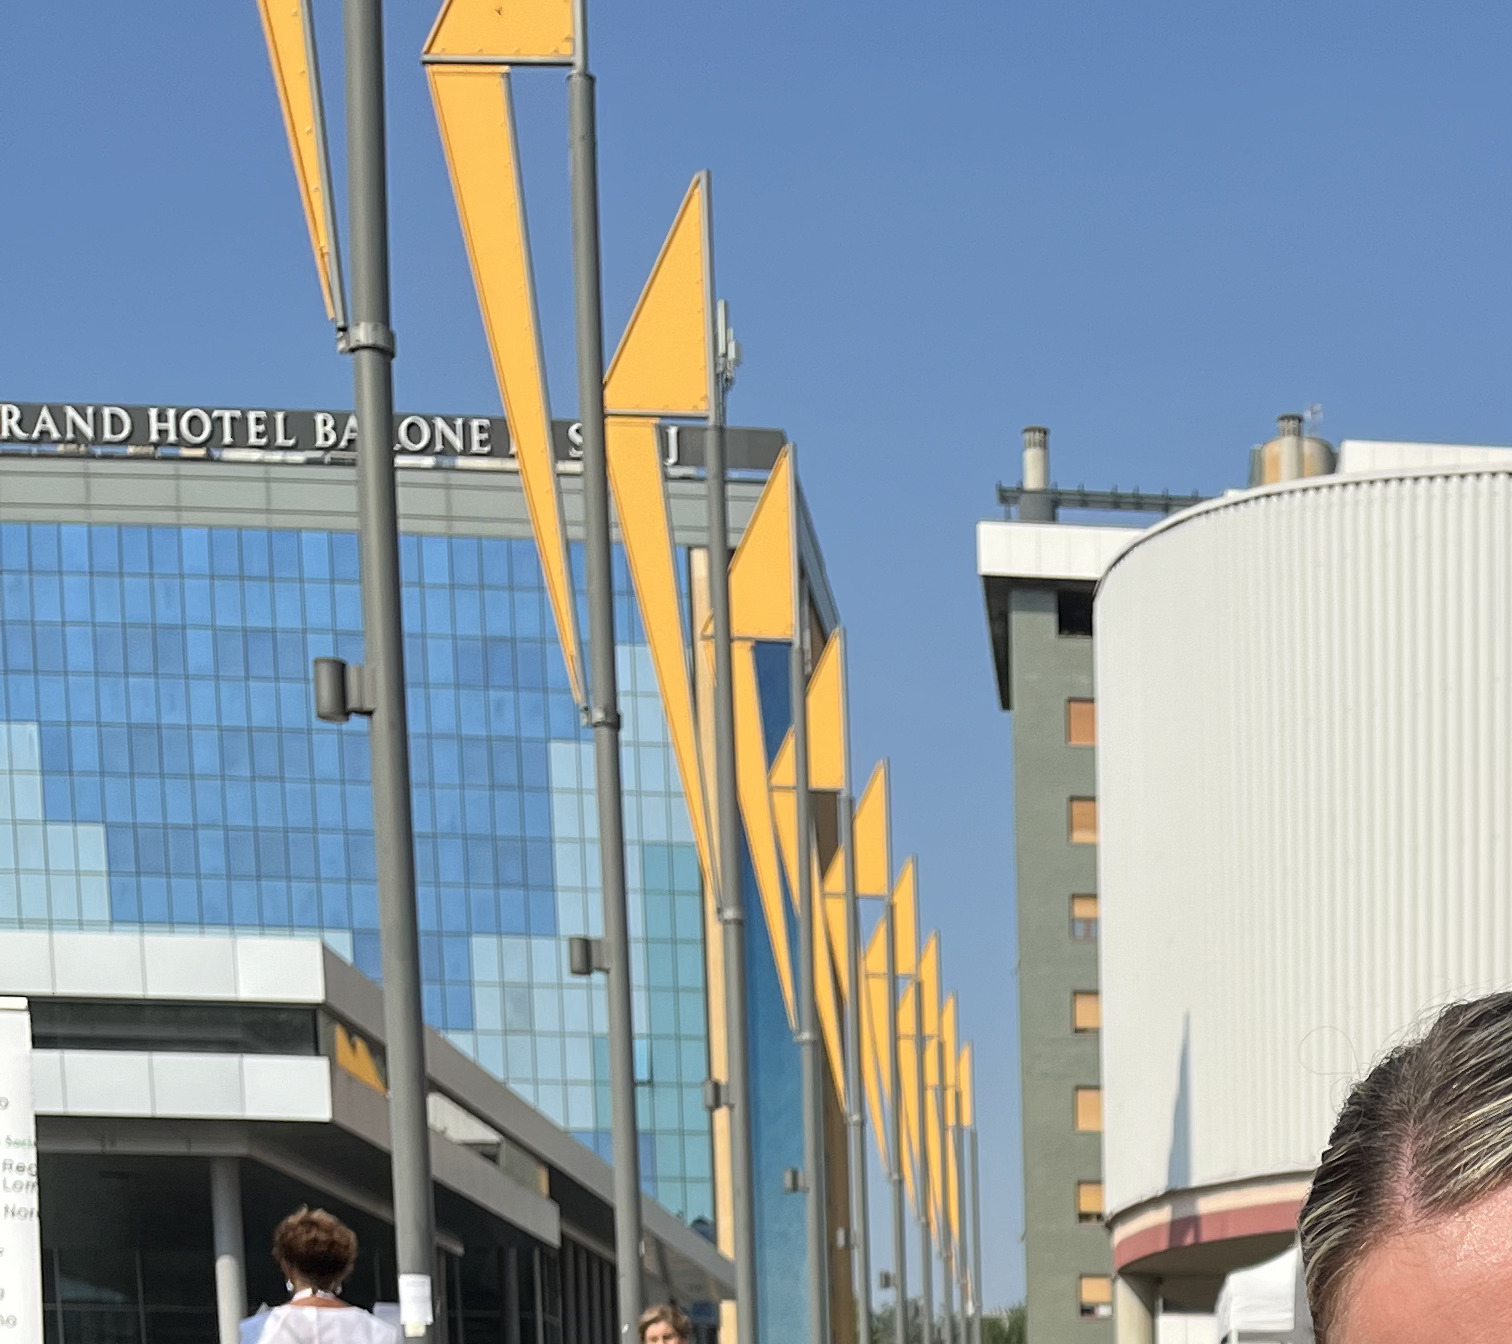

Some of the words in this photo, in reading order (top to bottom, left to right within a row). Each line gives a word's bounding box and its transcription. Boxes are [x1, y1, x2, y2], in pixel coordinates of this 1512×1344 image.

[0, 403, 133, 442] RAND
[148, 407, 296, 447] HOTEL
[314, 412, 492, 454] BAONE
